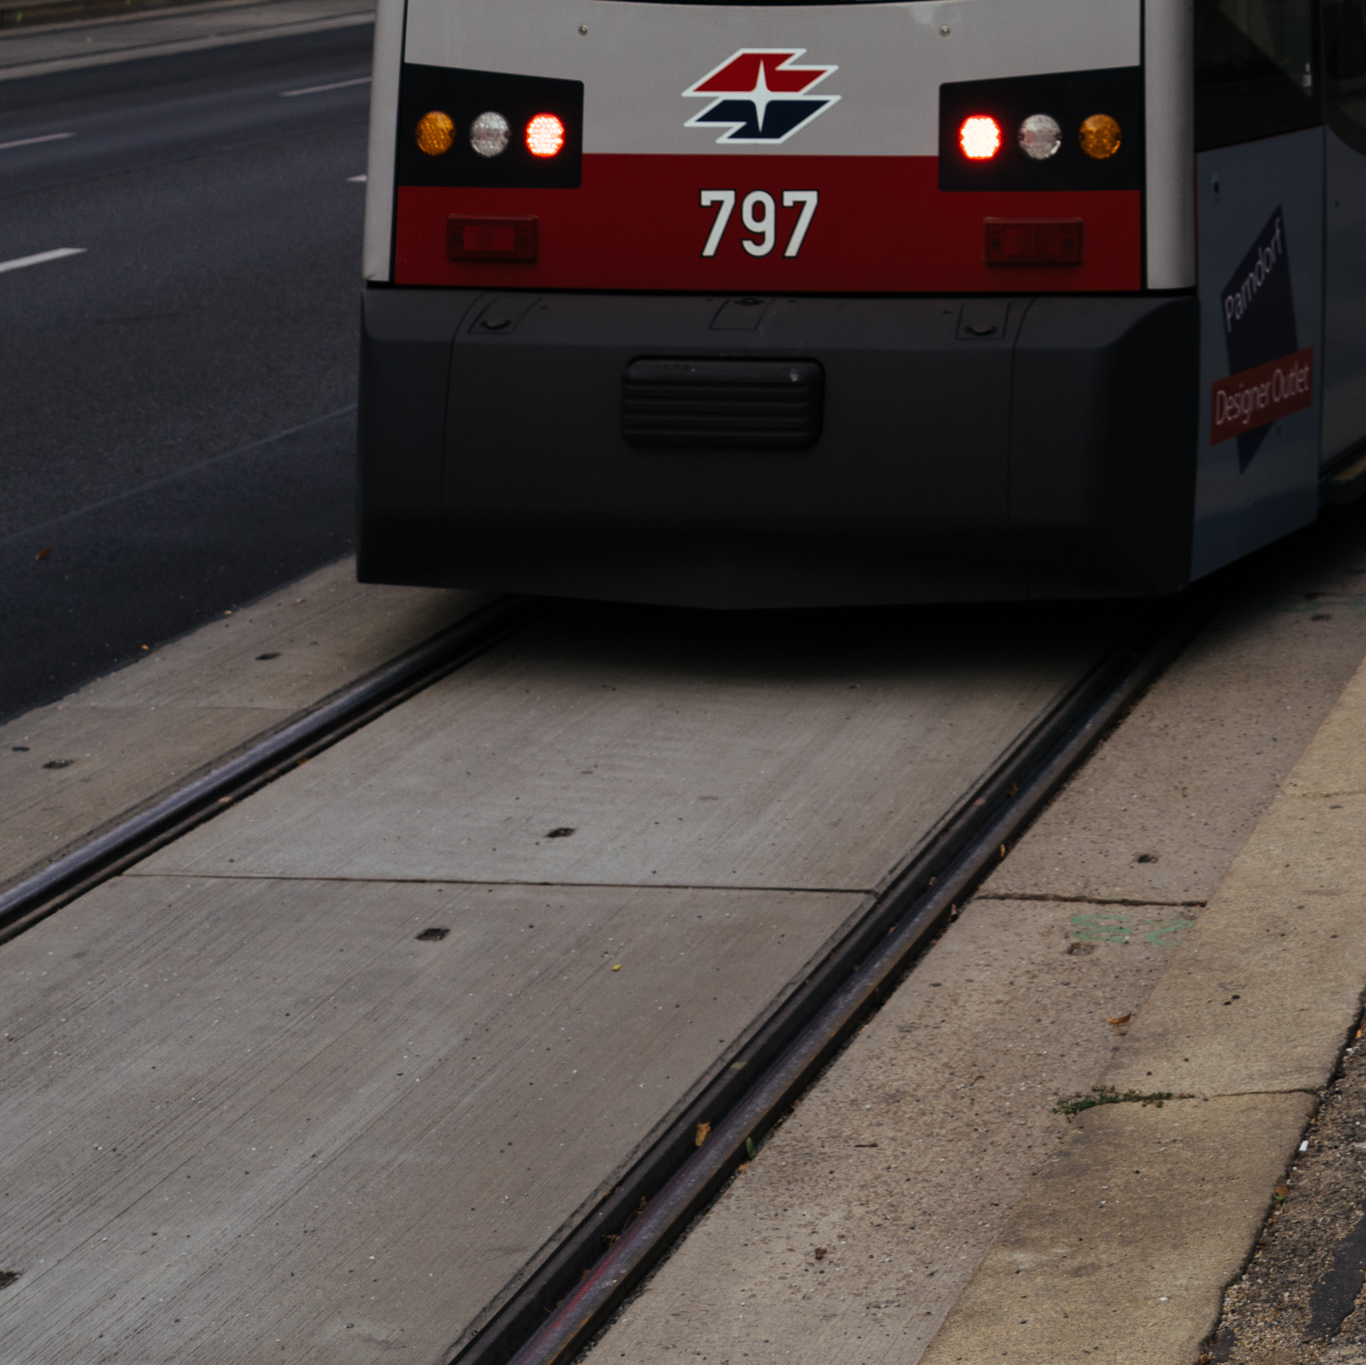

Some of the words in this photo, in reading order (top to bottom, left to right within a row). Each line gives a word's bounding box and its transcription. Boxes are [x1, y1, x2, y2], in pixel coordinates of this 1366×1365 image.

[700, 189, 820, 259] 797
[1224, 216, 1282, 333] Parndorf
[1215, 379, 1271, 425] Designer
[1271, 359, 1310, 403] Outlet
